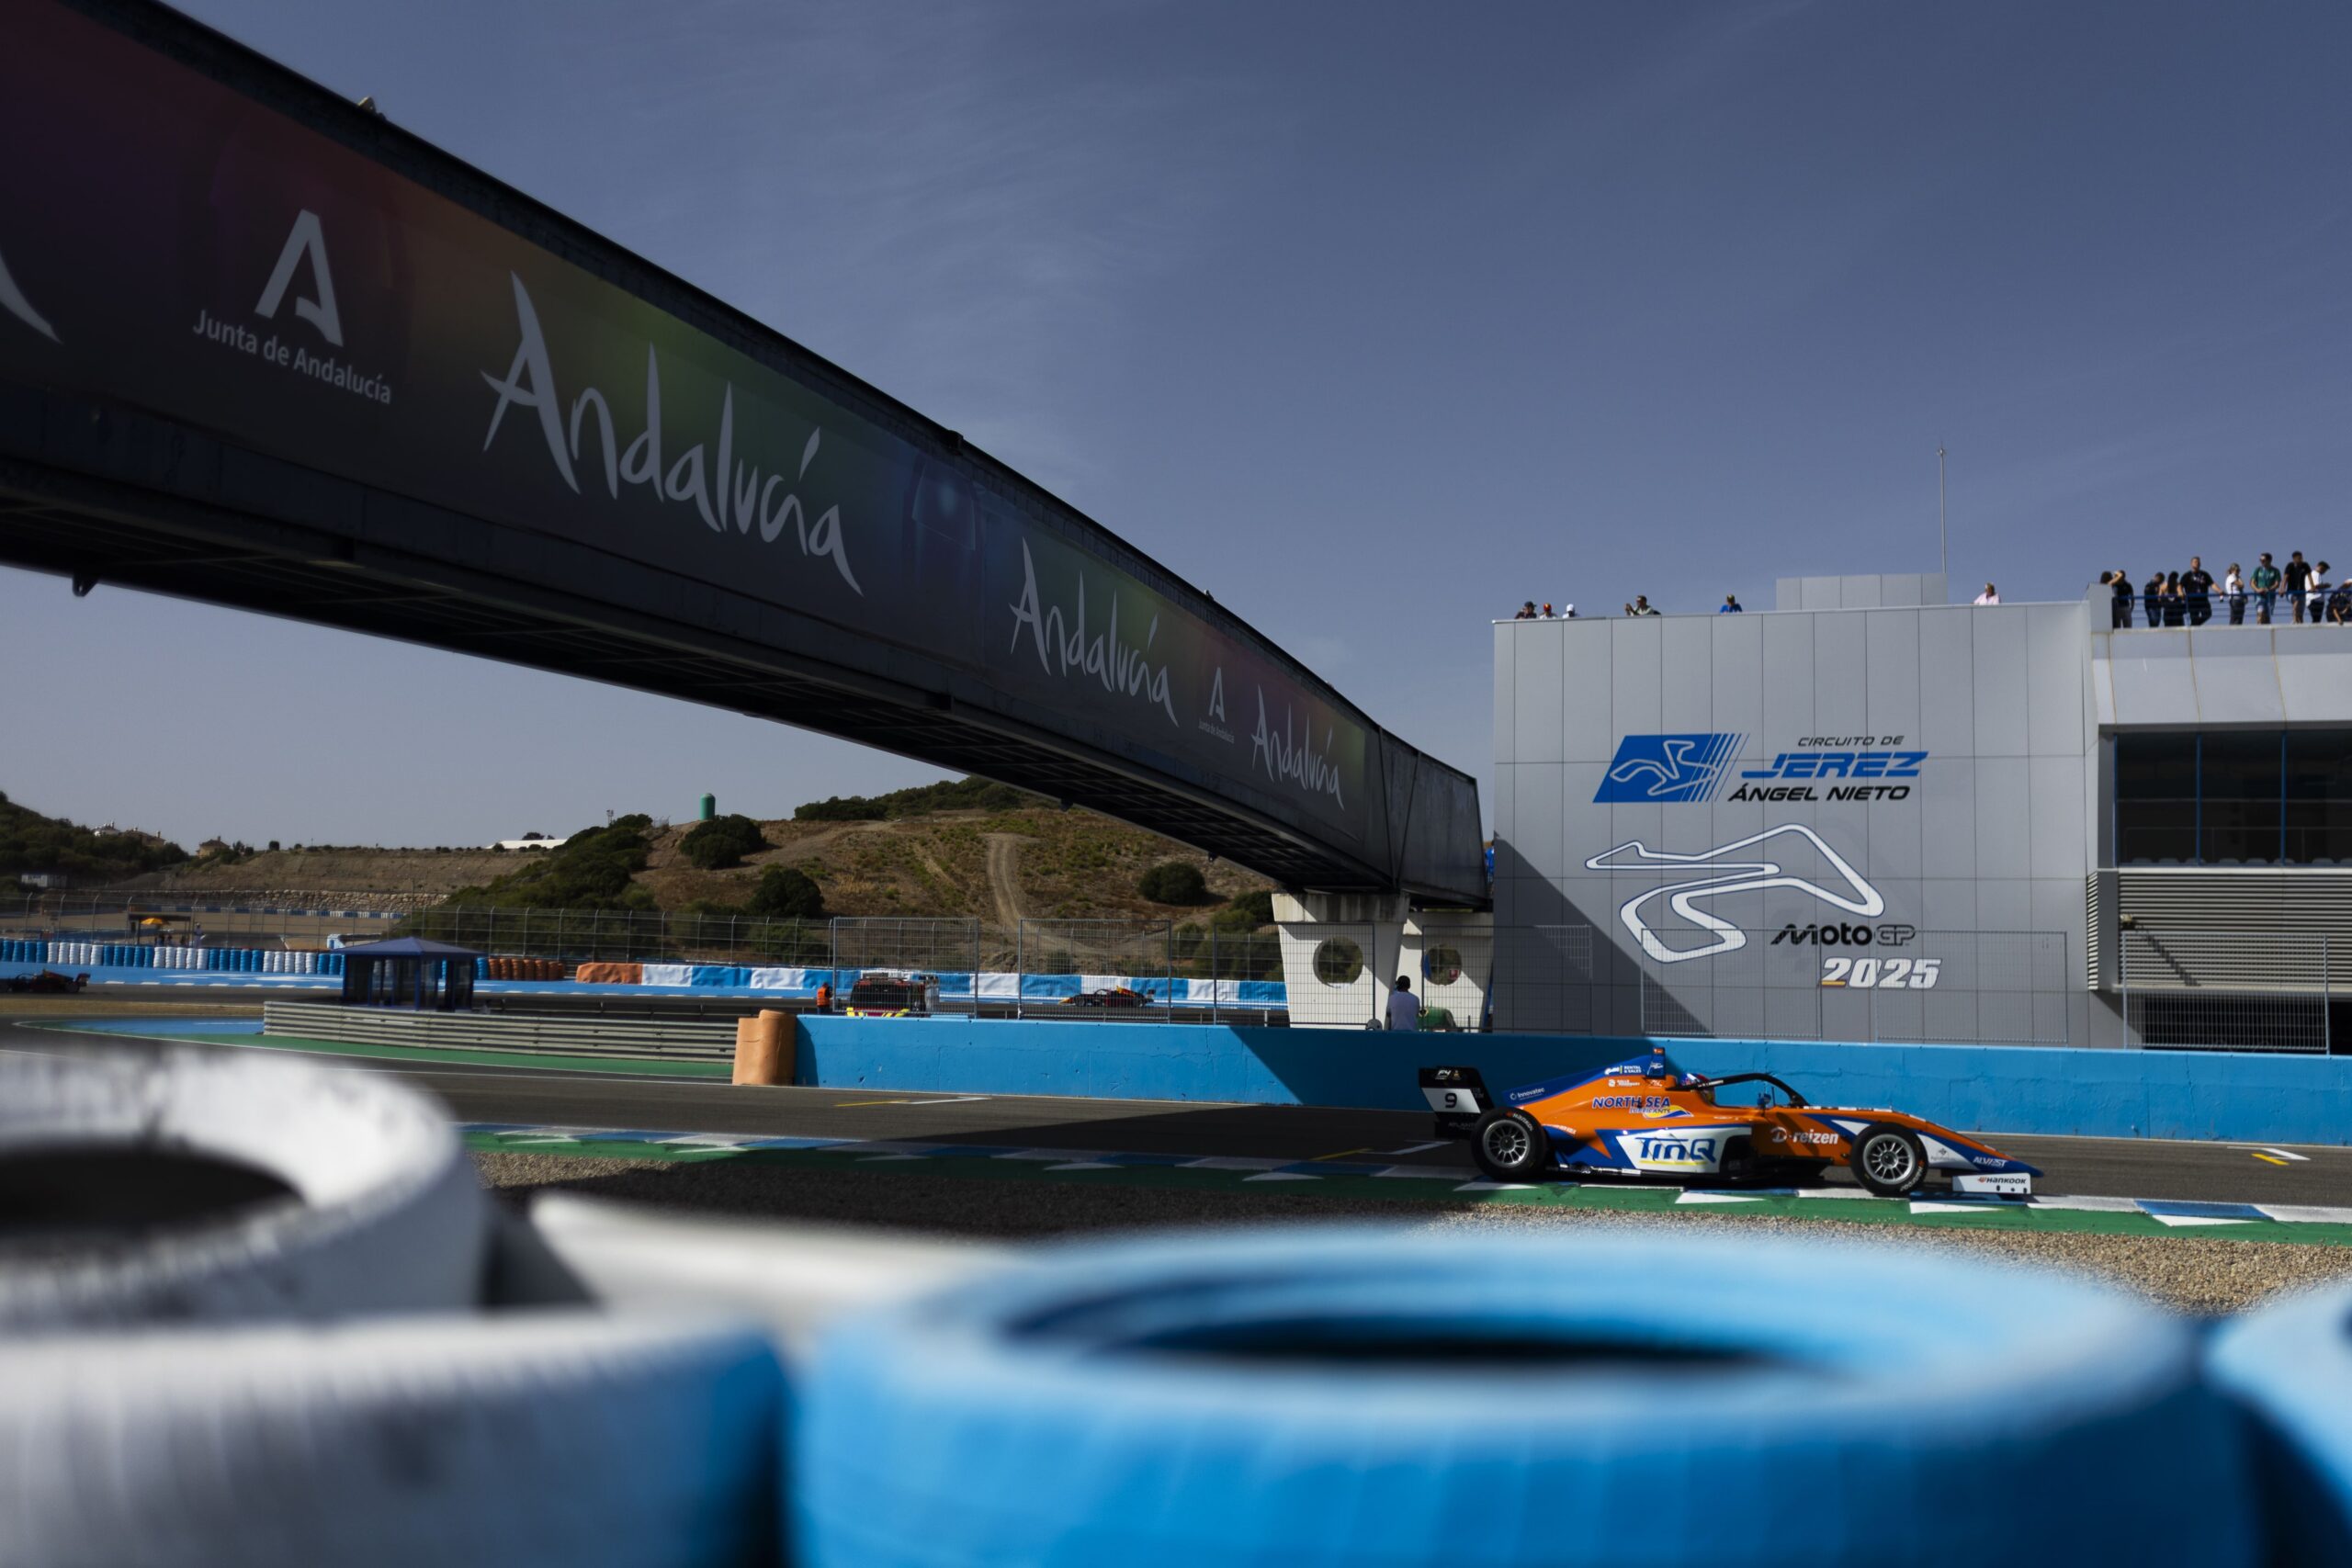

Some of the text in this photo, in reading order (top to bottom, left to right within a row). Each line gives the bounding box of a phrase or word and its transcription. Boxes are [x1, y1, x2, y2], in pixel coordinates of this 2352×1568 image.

[193, 310, 391, 404] Junta de Andalucía
[480, 270, 865, 597] Andalucía
[1009, 536, 1180, 728] Andalucía
[1250, 683, 1345, 811] Andalucía
[1798, 736, 1905, 747] CIRCUITO DE
[1741, 751, 1928, 778] JEREZ
[1727, 783, 1910, 801] ÁNGEL NIETO
[1820, 957, 1942, 989] 2025
[1444, 1092, 1458, 1109] 9
[1517, 1088, 1545, 1099] Innovatec
[1591, 1095, 1671, 1109] NORTH SEA
